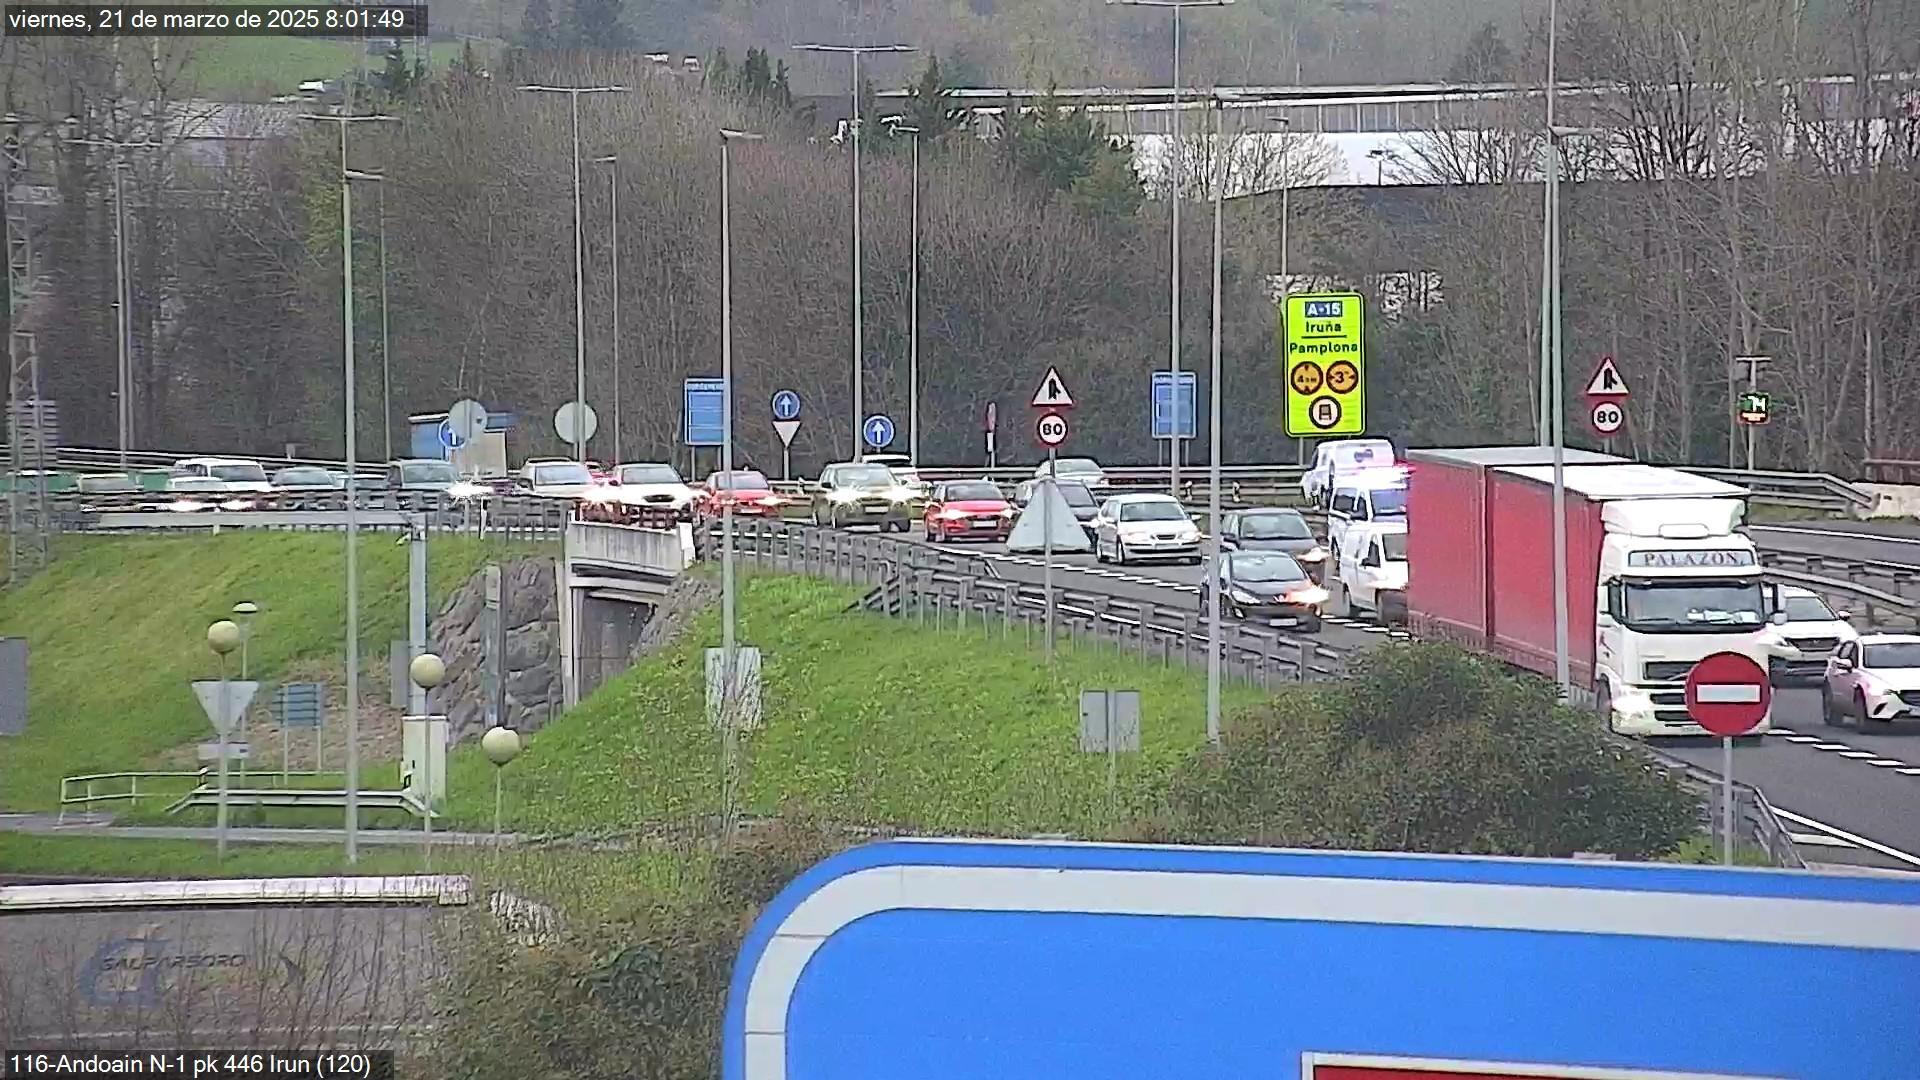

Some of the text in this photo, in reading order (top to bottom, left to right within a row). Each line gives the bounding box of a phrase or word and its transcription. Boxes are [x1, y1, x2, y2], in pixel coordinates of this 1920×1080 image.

[1308, 303, 1340, 316] A-15
[1305, 321, 1342, 333] Iruña
[1289, 342, 1358, 355] Pamplona
[1597, 411, 1619, 423] 80
[1043, 423, 1063, 435] 80
